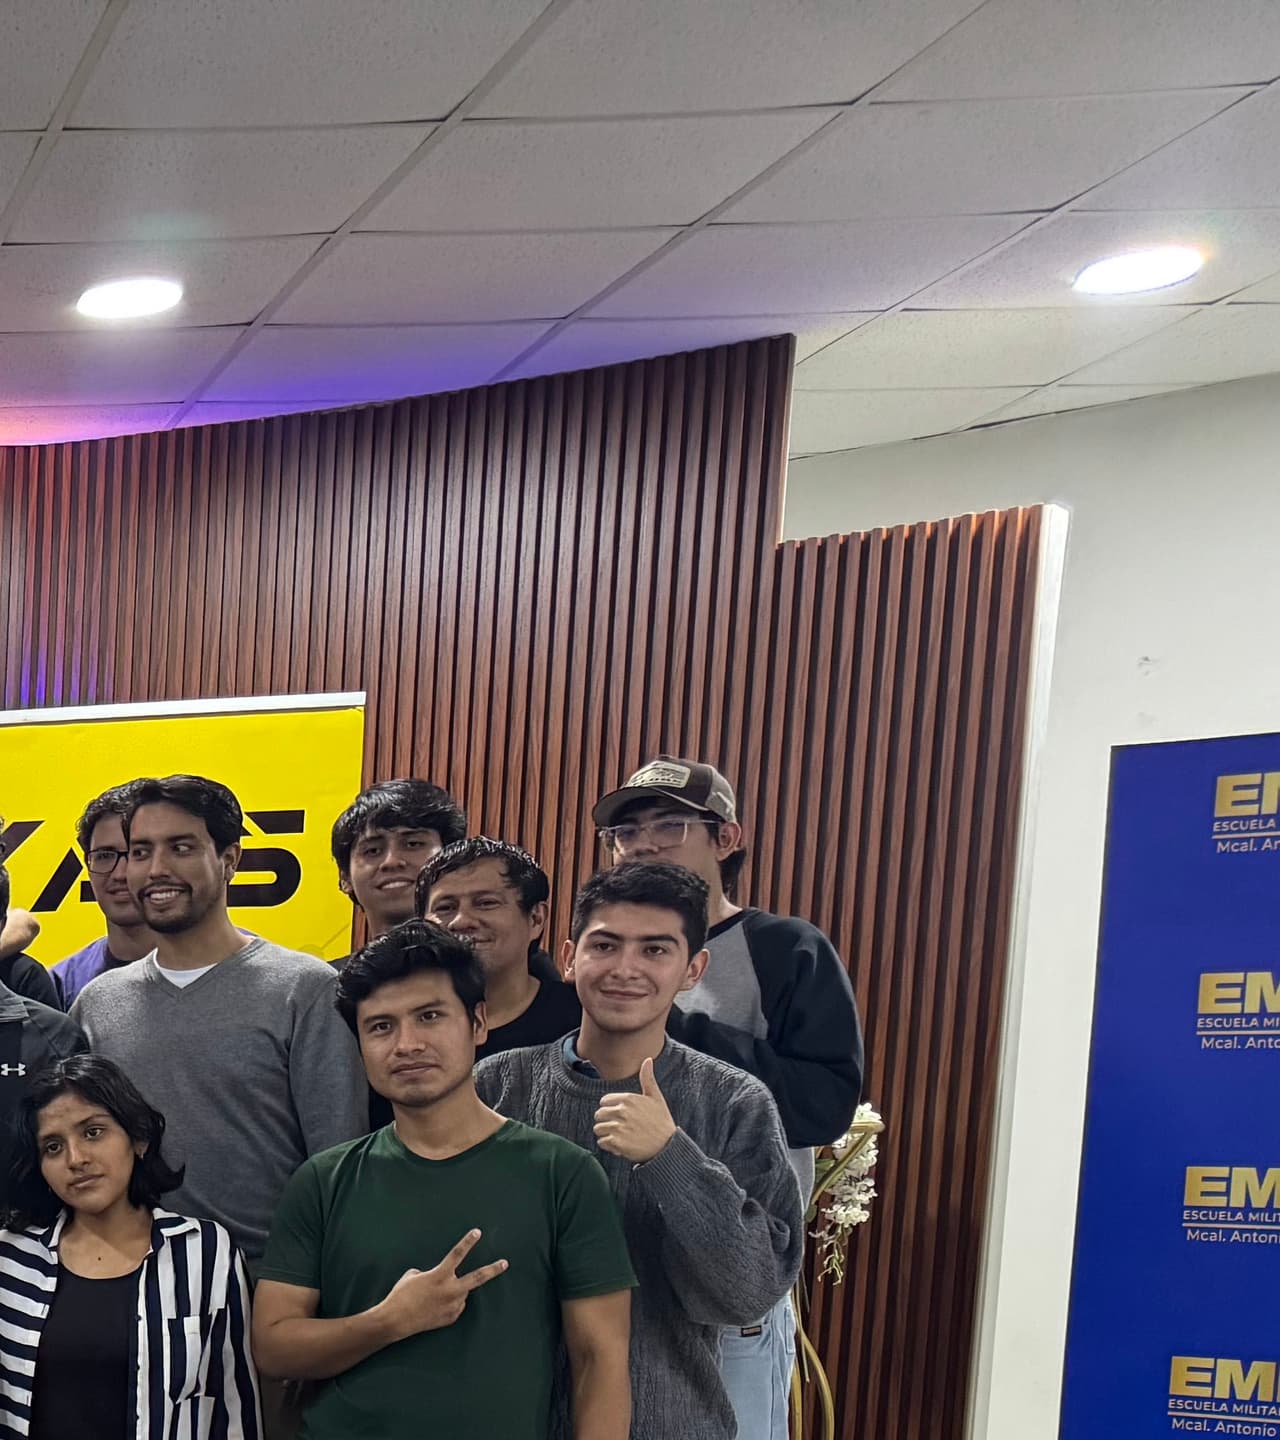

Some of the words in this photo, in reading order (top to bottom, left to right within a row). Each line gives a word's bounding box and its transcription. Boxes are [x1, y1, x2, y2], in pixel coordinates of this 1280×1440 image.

[1213, 818, 1276, 832] ESCUELA
[1216, 838, 1257, 853] Mcal.
[1197, 1017, 1259, 1028] ESCUELA
[1201, 1036, 1242, 1049] Mcal.
[1183, 1166, 1280, 1209] EM
[1183, 1210, 1244, 1222] ESCUELA
[1187, 1228, 1227, 1242] Mcal.
[1168, 1355, 1280, 1403] EM
[1168, 1398, 1229, 1413] ESCUELA
[1233, 1403, 1280, 1417] MILITA
[1172, 1417, 1211, 1432] Mcal.
[1214, 1421, 1277, 1437] Antonio
